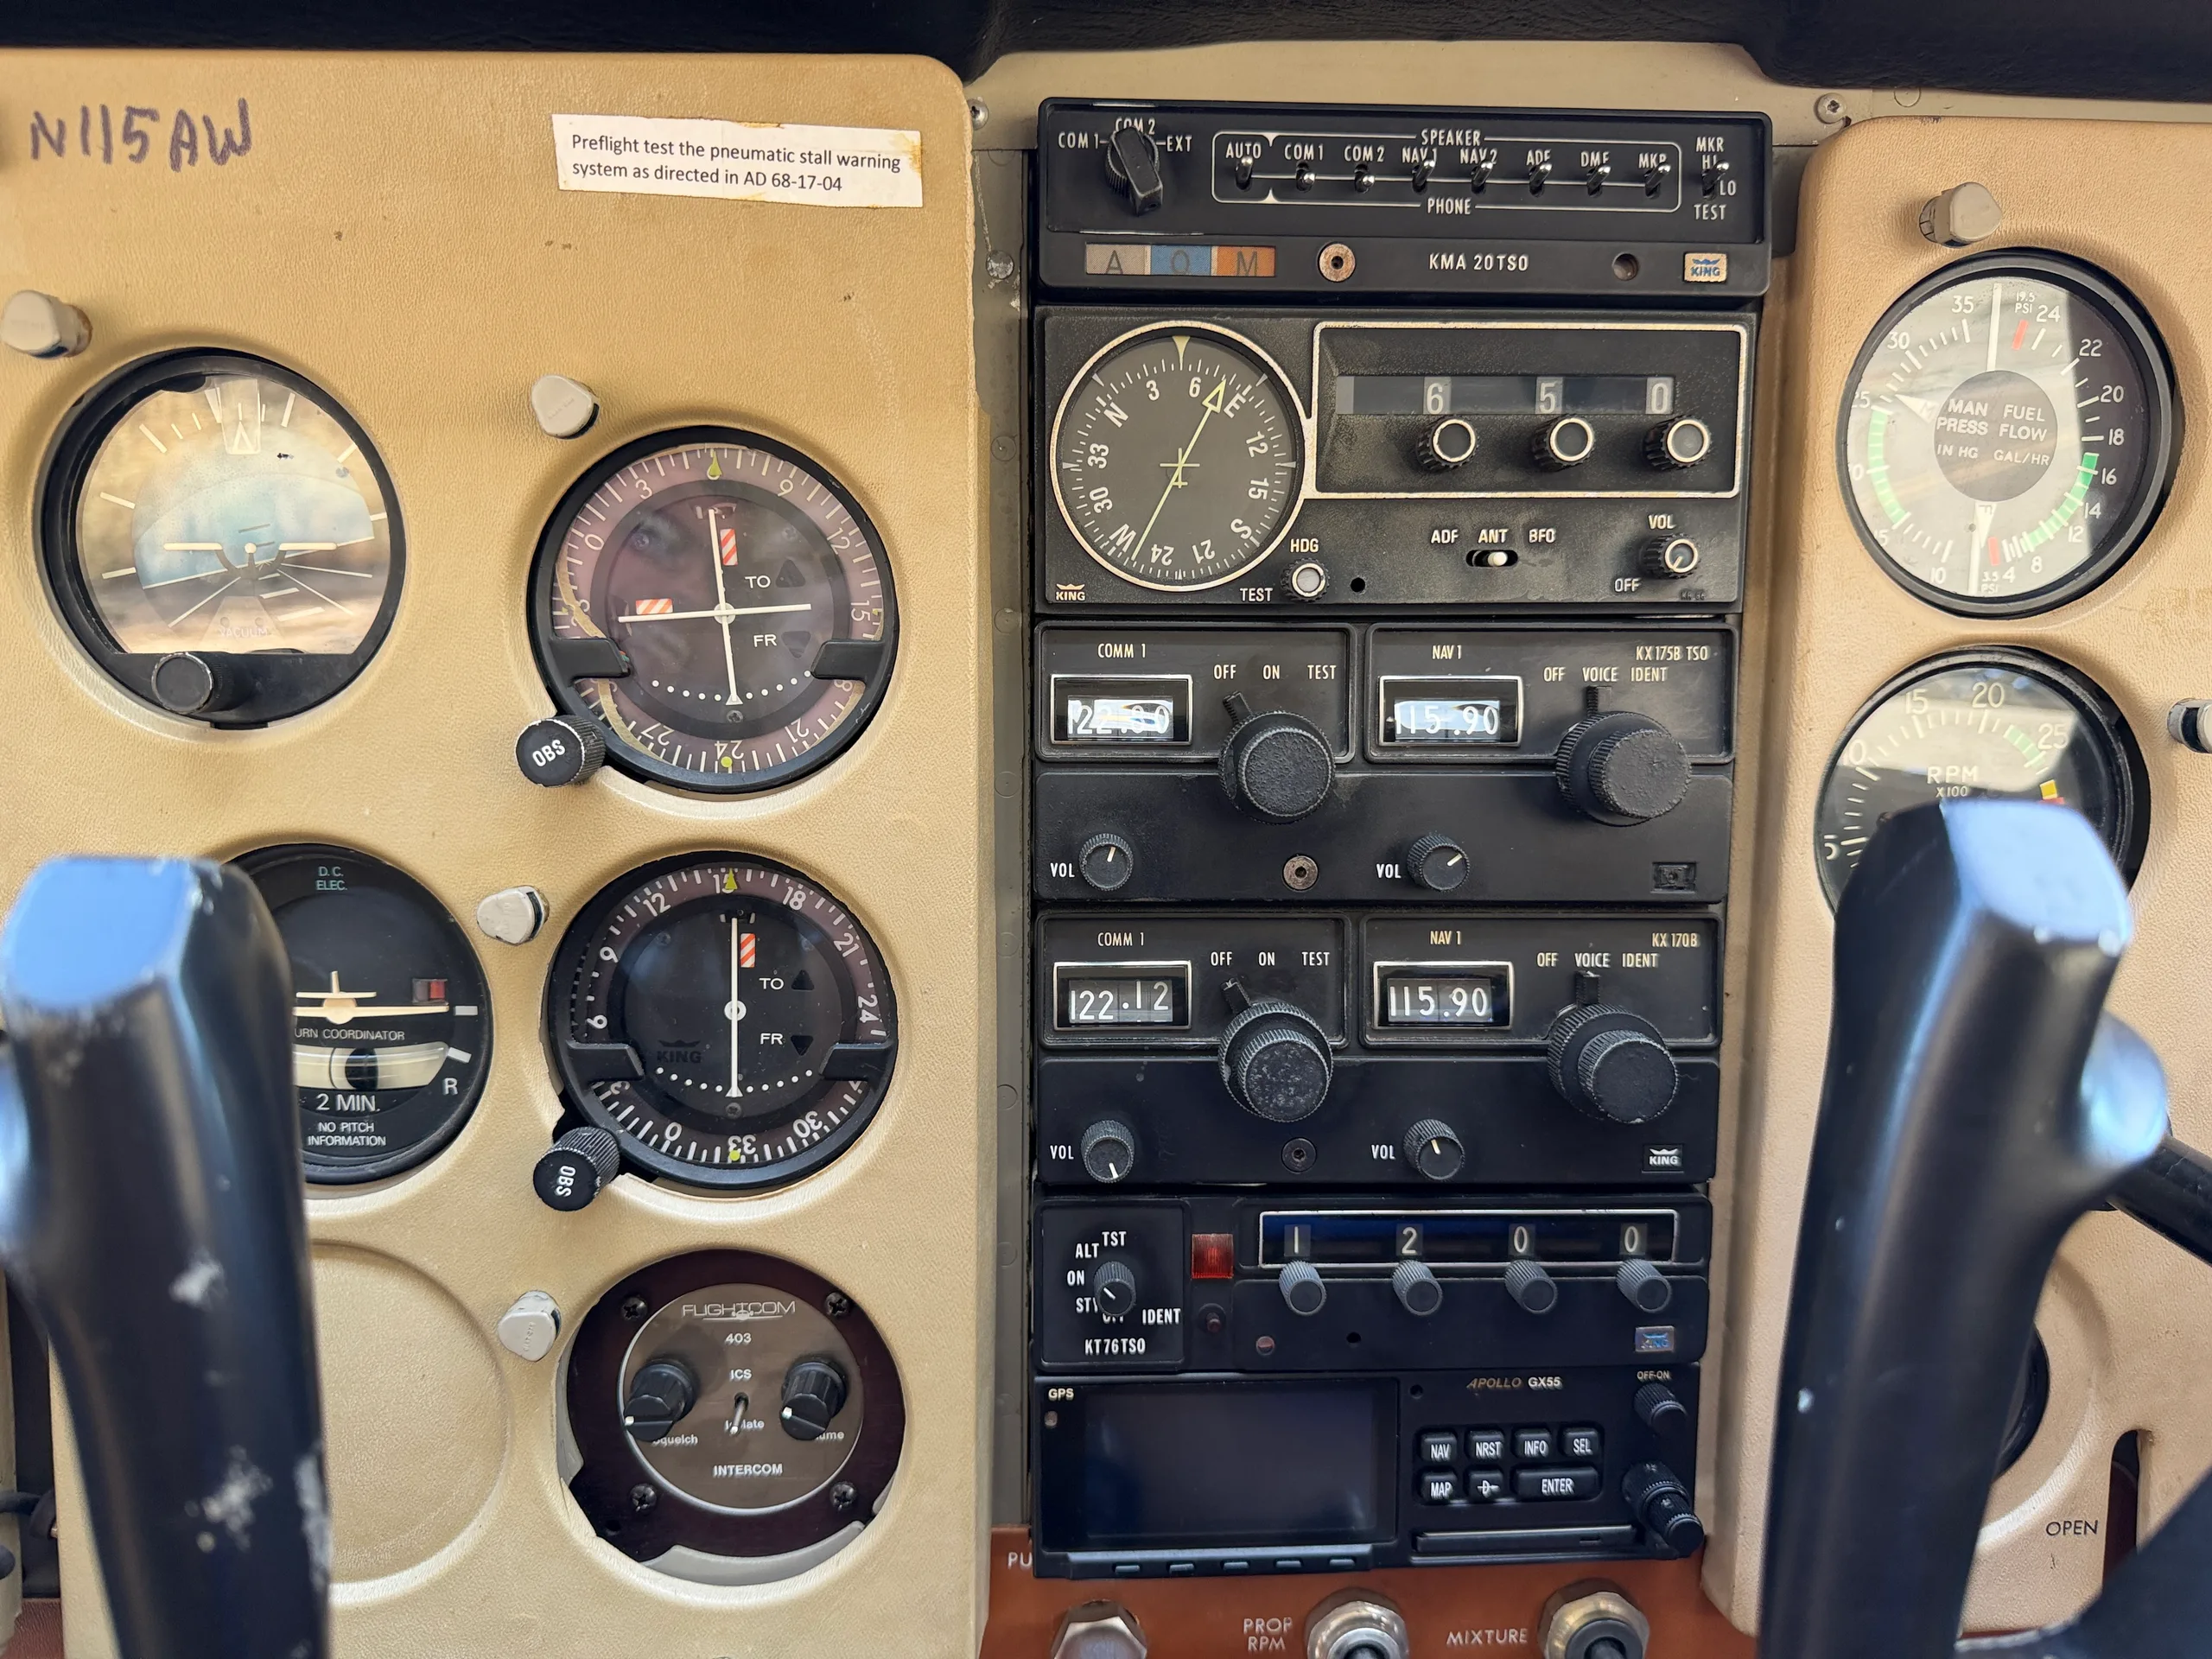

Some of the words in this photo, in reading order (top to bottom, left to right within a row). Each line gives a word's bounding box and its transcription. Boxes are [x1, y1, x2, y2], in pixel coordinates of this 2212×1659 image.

[30, 98, 252, 171] N115AW
[1148, 118, 1155, 135] 2
[1058, 132, 1089, 149] COM
[1094, 133, 1099, 149] 1
[1166, 136, 1192, 152] EXT
[1421, 128, 1481, 146] SPEAKER
[1696, 137, 1724, 152] MKR
[572, 134, 639, 154] Preflight
[644, 140, 674, 156] test
[679, 141, 705, 157] the
[710, 144, 795, 163] pneumatic
[799, 149, 831, 167] stall
[837, 153, 900, 173] warning
[1226, 143, 1262, 159] AUTO
[1285, 143, 1314, 161] COM
[1319, 144, 1324, 161] 1
[1344, 145, 1374, 162] COM
[1377, 145, 1385, 162] 2
[1402, 146, 1428, 163] NAV
[1460, 147, 1487, 164] NAV
[1490, 148, 1497, 164] 2
[572, 162, 627, 178] system
[632, 166, 649, 179] as
[654, 165, 719, 184] directed
[725, 168, 738, 185] in
[744, 171, 766, 187] AD
[772, 173, 842, 192] 68-17-04
[1719, 181, 1736, 196] LO
[1427, 198, 1471, 215] PHONE
[1694, 204, 1726, 220] TEST
[1429, 253, 1466, 270] KMA
[1690, 266, 1720, 277] KING
[2015, 291, 2035, 302] 19.5
[1951, 296, 1974, 314] 35
[2014, 302, 2032, 315] PSI
[2036, 305, 2061, 323] 24
[1887, 332, 1910, 350] 30
[2079, 339, 2102, 357] 22
[1427, 383, 1443, 415] 6
[1538, 383, 1556, 414] 5
[1650, 382, 1669, 413] 0
[2100, 385, 2124, 403] 20
[1948, 399, 1987, 416] MAN
[2003, 404, 2045, 423] FUEL
[1936, 416, 1988, 435] PRESS
[1999, 423, 2047, 442] FLOW
[2107, 429, 2125, 446] 18
[1937, 445, 1952, 456] IN
[1958, 447, 1979, 459] HG
[1993, 449, 2050, 466] GAL/HR
[2101, 467, 2117, 486] 16
[2084, 502, 2101, 518] 14
[1648, 515, 1674, 530] VOL
[827, 526, 850, 556] 12
[1431, 529, 1459, 544] ADF
[1478, 529, 1509, 543] ANT
[1529, 528, 1555, 543] BFO
[2068, 526, 2083, 543] 12
[1290, 538, 1319, 553] HDG
[745, 575, 772, 588] TO
[1614, 578, 1640, 593] OFF
[1056, 592, 1085, 601] KING
[1240, 588, 1273, 602] TEST
[850, 601, 872, 622] 15
[753, 634, 778, 646] FR
[1097, 644, 1135, 658] COMM
[1141, 644, 1147, 658] 1
[1433, 645, 1454, 660] NAV
[1457, 645, 1462, 660] 1
[1687, 645, 1708, 661] TSO
[1213, 664, 1236, 680] OFF
[1262, 664, 1281, 680] ON
[1307, 664, 1337, 680] TEST
[1543, 666, 1566, 682] OFF
[1582, 666, 1618, 683] VOICE
[1630, 666, 1668, 683] IDENT
[1904, 689, 1929, 715] 15
[1972, 682, 2005, 709] 20
[1395, 705, 1499, 735] 115.90
[640, 722, 670, 747] 27
[785, 721, 810, 741] 21
[2037, 723, 2069, 750] 25
[531, 739, 566, 767] OBS
[715, 741, 745, 760] 24
[1927, 765, 1979, 785] RPM
[1050, 862, 1075, 878] VOL
[1376, 864, 1401, 880] VOL
[316, 880, 347, 892] ELEC.
[642, 892, 671, 918] 12
[783, 887, 806, 911] 18
[834, 932, 860, 957] 21
[1097, 932, 1133, 947] COMM
[1140, 932, 1145, 946] 1
[1430, 931, 1452, 945] NAV
[1457, 931, 1461, 945] 1
[1210, 952, 1232, 966] OFF
[1258, 952, 1275, 966] ON
[1301, 952, 1330, 966] TEST
[1537, 952, 1558, 967] OFF
[1574, 952, 1610, 967] VOICE
[1622, 952, 1659, 968] IDENT
[759, 978, 785, 990] TO
[857, 995, 879, 1023] 24
[1389, 985, 1489, 1019] 115.90
[294, 1028, 318, 1039] URN
[322, 1029, 405, 1041] COORDINATOR
[760, 1033, 784, 1046] FR
[658, 1051, 702, 1064] KING
[442, 1078, 459, 1096] R
[316, 1093, 329, 1111] 2
[337, 1094, 380, 1112] MIN.
[318, 1122, 336, 1133] NO
[341, 1122, 375, 1133] PITCH
[793, 1110, 823, 1138] 30
[308, 1135, 386, 1146] INFORMATION
[1050, 1145, 1074, 1160] VOL
[1371, 1145, 1395, 1160] VOL
[1649, 1155, 1679, 1166] KING
[556, 1165, 575, 1198] OBS
[1102, 1231, 1127, 1247] TST
[1401, 1226, 1416, 1255] 2
[1513, 1225, 1529, 1253] 0
[1624, 1225, 1639, 1253] 0
[1076, 1243, 1099, 1259] ALT
[1066, 1270, 1084, 1286] ON
[1142, 1308, 1181, 1325] IDENT
[725, 1332, 752, 1345] 403
[729, 1369, 753, 1381] ICS
[1467, 1377, 1522, 1389] APOLLO
[1528, 1376, 1562, 1389] GX55
[1637, 1370, 1671, 1381] OFF-ON
[1048, 1388, 1074, 1402] GPS
[1431, 1444, 1451, 1462] NAV
[1476, 1441, 1502, 1458] NRST
[1524, 1440, 1548, 1455] INFO
[1573, 1439, 1592, 1453] SEL
[713, 1464, 783, 1477] INTERCOM
[1431, 1483, 1453, 1500] MAP
[1541, 1478, 1574, 1494] ENTER
[2046, 1520, 2099, 1536] OPEN
[1243, 1617, 1294, 1635] PROP
[1248, 1636, 1286, 1652] RPM
[1446, 1628, 1528, 1646] MIXTURE
